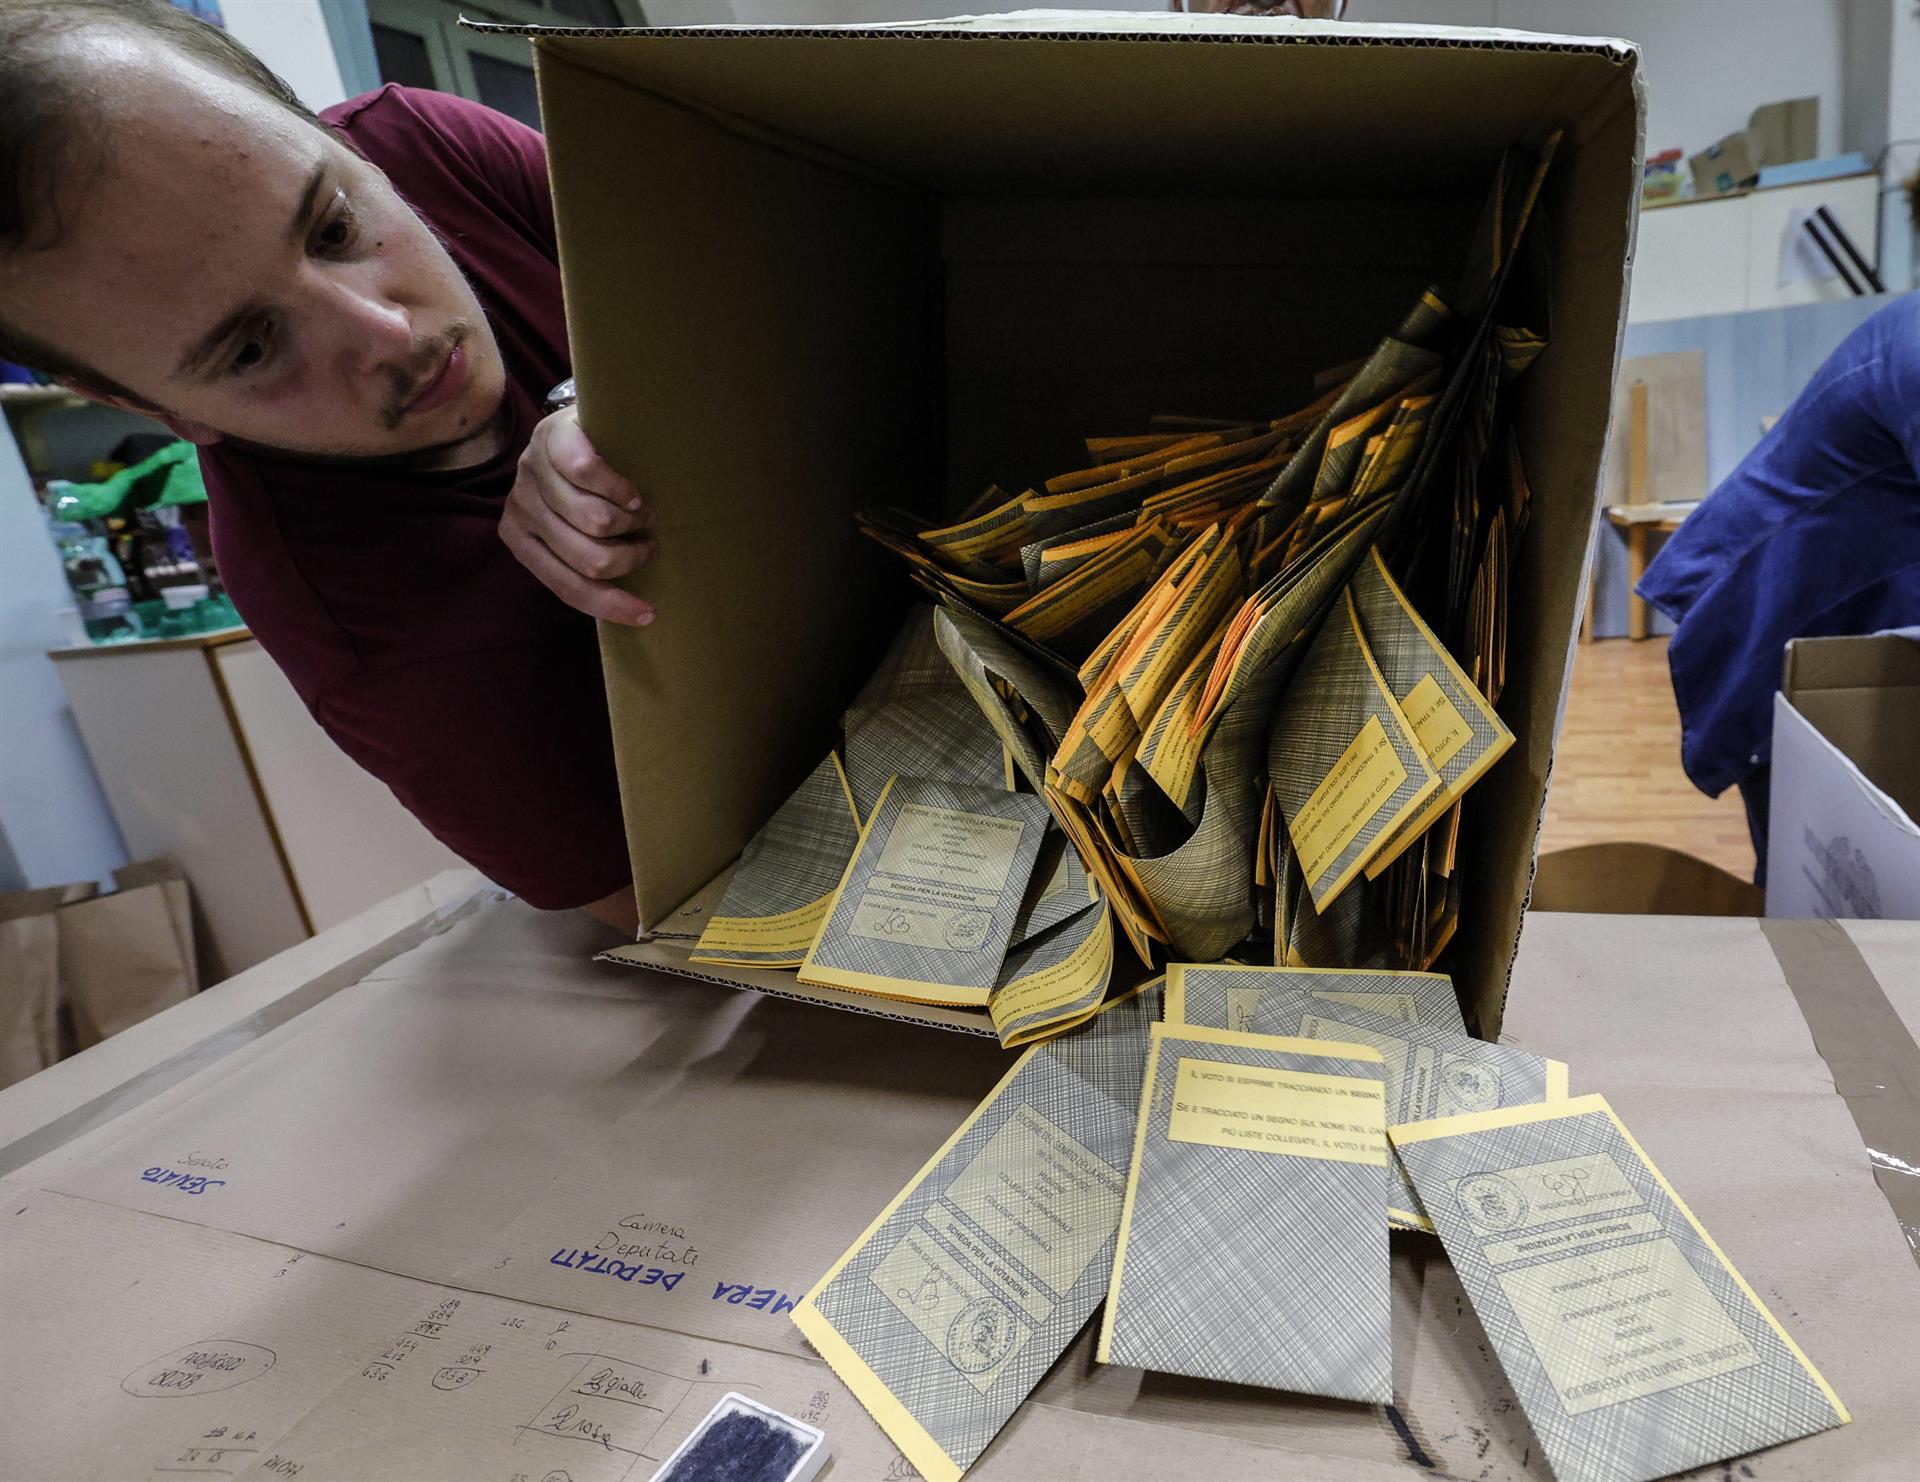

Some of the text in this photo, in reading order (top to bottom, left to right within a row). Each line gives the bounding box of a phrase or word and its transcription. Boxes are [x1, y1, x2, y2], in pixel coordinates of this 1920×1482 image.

[1433, 734, 1451, 754] VOTO
[1349, 751, 1374, 783] TRACCIATO
[1343, 779, 1351, 792] UN
[1369, 790, 1376, 800] SI
[1375, 775, 1388, 793] VOTO
[1329, 788, 1344, 809] SEGNO
[1351, 796, 1371, 822] ESPRIME
[1324, 820, 1351, 853] TRACCIANDO
[889, 883, 917, 892] SCHEDA
[940, 891, 976, 902] VOTAZIONE
[1190, 1070, 1198, 1078] IL
[1200, 1072, 1224, 1081] VOTO
[1237, 1077, 1274, 1088] ESPRIME
[1278, 1081, 1333, 1094] TRACCIANDO
[1335, 1088, 1347, 1096] UN
[1350, 1090, 1380, 1100] SEGNO
[1200, 1106, 1248, 1119] TRACCIATO
[1250, 1112, 1264, 1121] UN
[1266, 1114, 1297, 1125] SEGNO
[1299, 1118, 1315, 1128] SUL
[1319, 1121, 1345, 1131] NOME
[1349, 1124, 1365, 1133] DEL
[1238, 1129, 1263, 1139] LISTE
[1266, 1132, 1319, 1147] COLLEGATE,
[1322, 1139, 1329, 1147] IL
[1333, 1140, 1358, 1151] VOTO
[1051, 1138, 1078, 1163] SENATO
[1073, 1155, 1098, 1178] DELLA
[619, 1213, 687, 1240] Camera
[1514, 1221, 1632, 1253] SCHEDA PER LA VOTAZIONE
[594, 1231, 699, 1267] Deputati
[945, 1222, 1029, 1300] SCHEDA PER LA VOTAZIONE
[550, 1248, 686, 1292] DEPUTATI
[1618, 1365, 1654, 1387] DELLA
[1649, 1356, 1690, 1379] SENATO
[1560, 1373, 1623, 1404] REPUBBLICA
